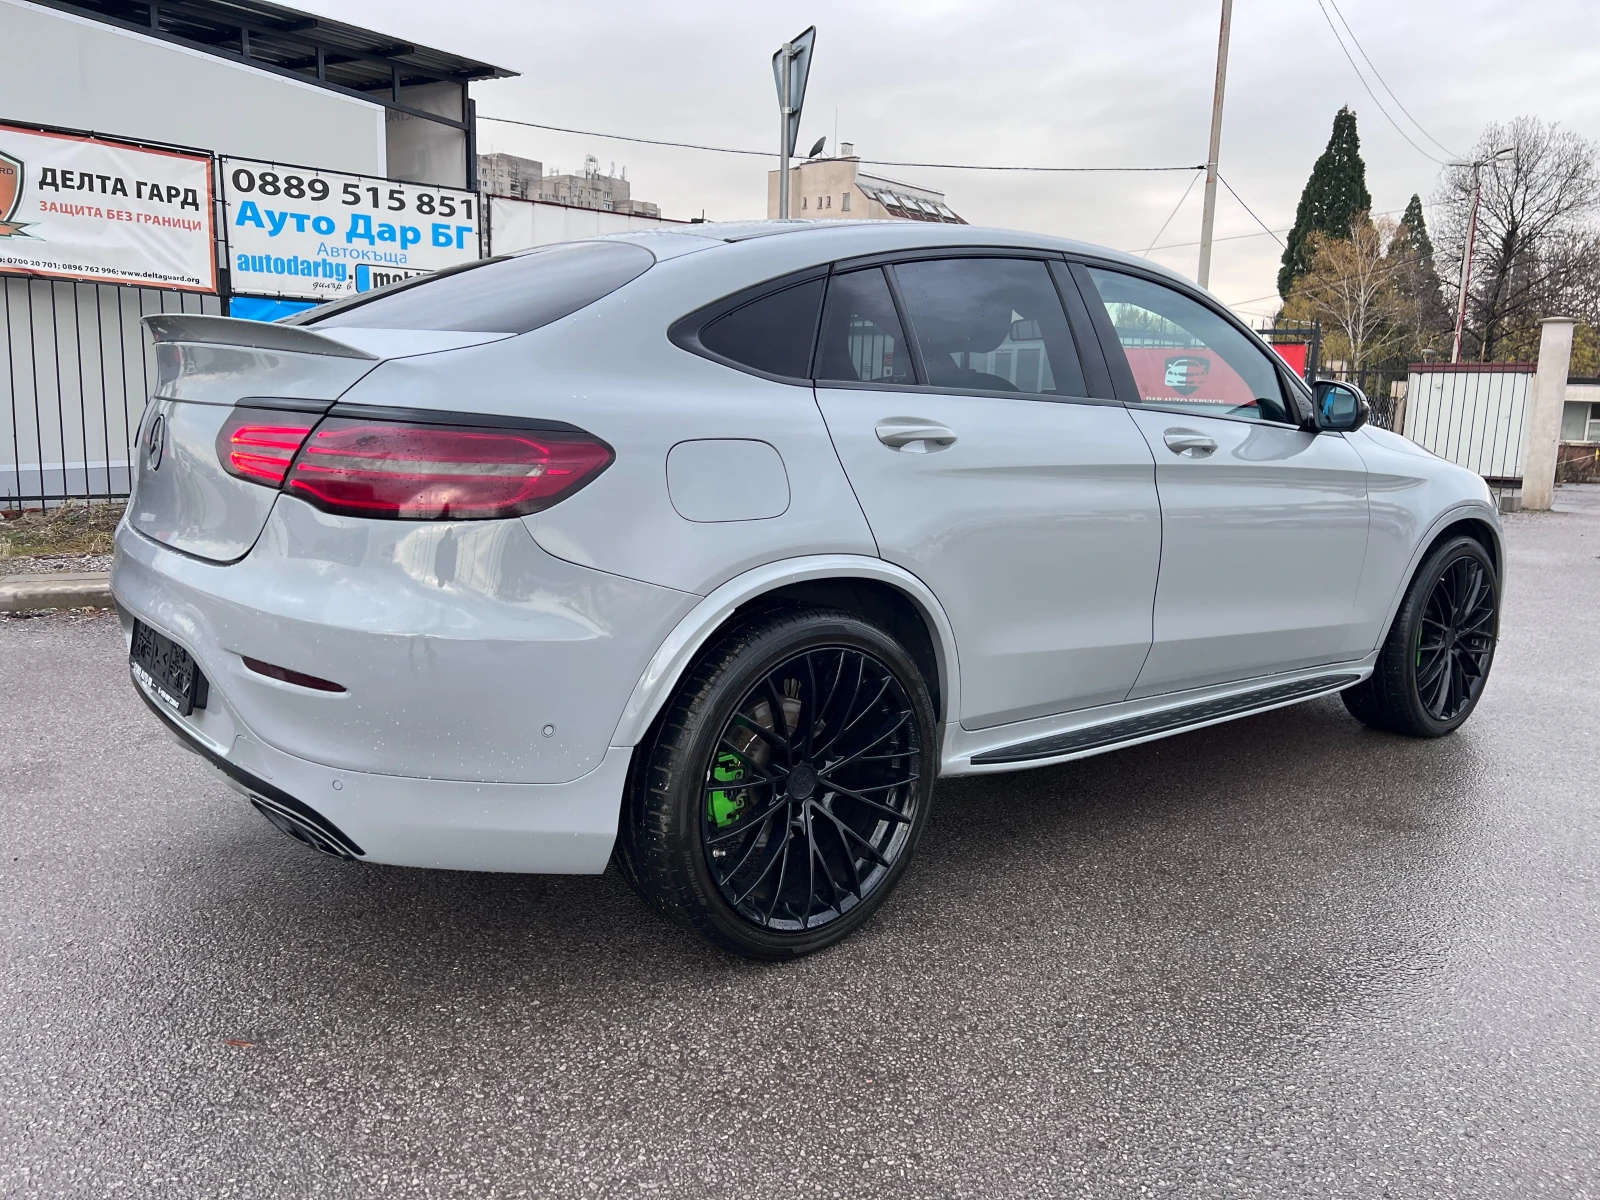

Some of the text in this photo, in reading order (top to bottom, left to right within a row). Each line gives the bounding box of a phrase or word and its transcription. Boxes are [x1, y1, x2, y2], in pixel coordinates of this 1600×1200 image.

[38, 167, 200, 211] ДЕЛТА ГАРД
[232, 168, 473, 220] 0889 515 851
[39, 200, 202, 232] ЗАЩИТА БЕЗ ГРАНИЦИ
[235, 200, 473, 250] Ауто Дар БГ
[7, 257, 28, 265] 0700
[42, 261, 61, 270] 701;
[62, 263, 83, 272] 0896
[84, 265, 100, 273] 762
[120, 270, 200, 285] www.deltaguard.org
[316, 242, 408, 266] Автокъща
